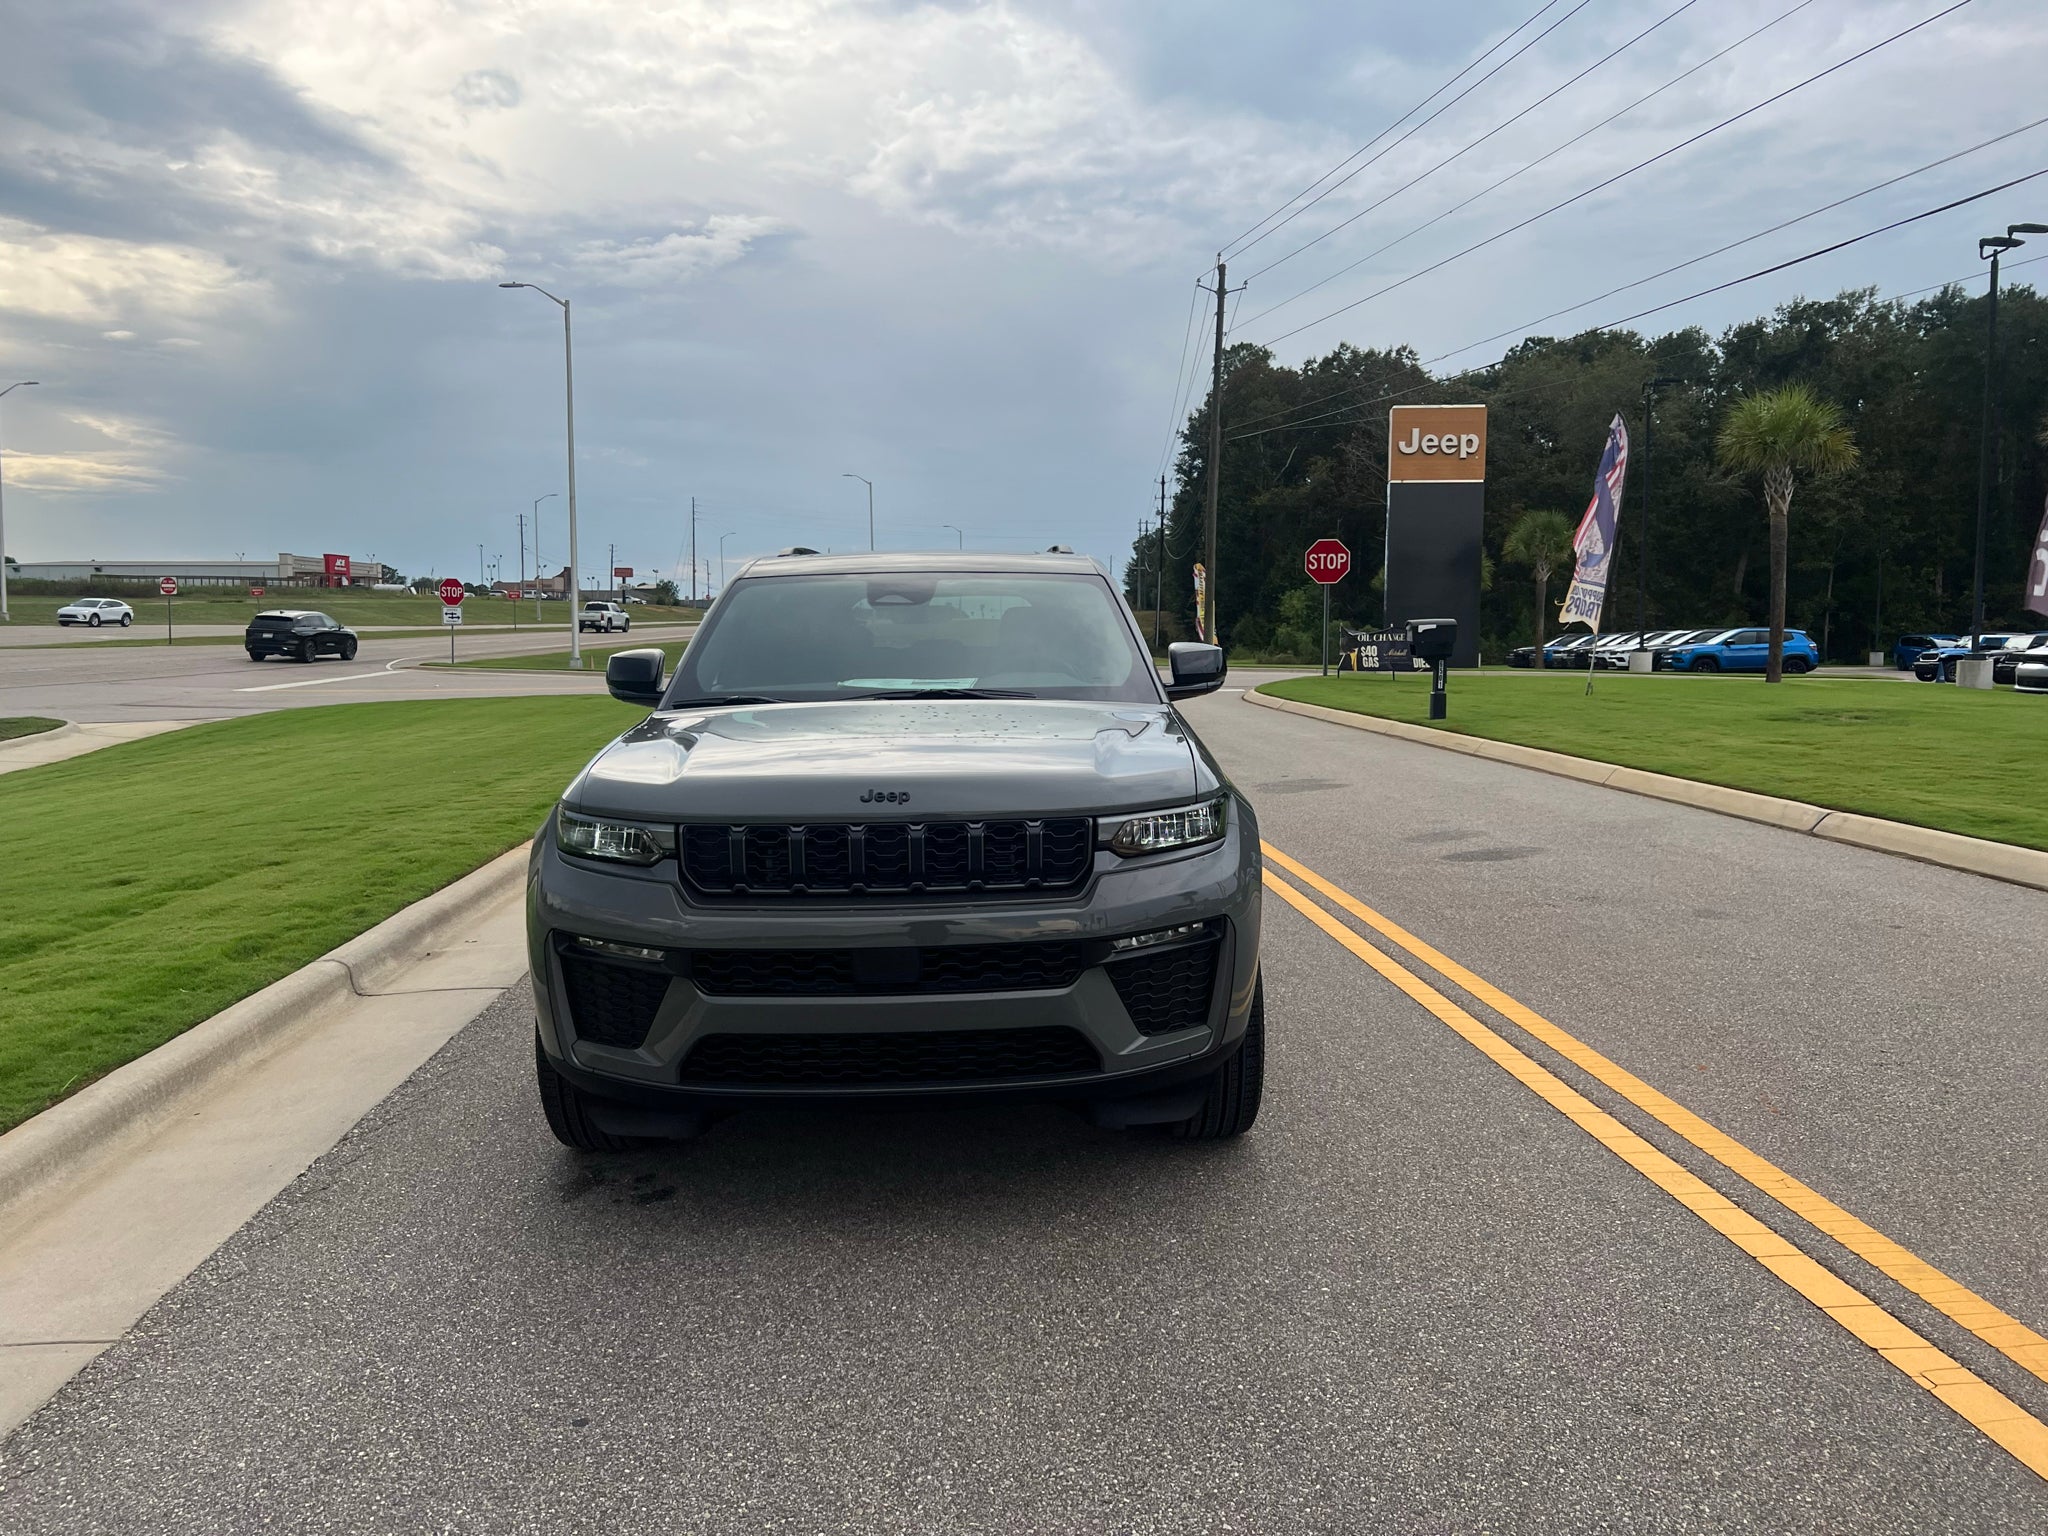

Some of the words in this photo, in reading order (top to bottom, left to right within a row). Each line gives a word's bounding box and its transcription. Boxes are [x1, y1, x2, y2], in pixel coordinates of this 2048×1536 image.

[1398, 427, 1480, 459] Jeep
[1308, 553, 1347, 570] STOP
[441, 586, 463, 598] STOP
[1357, 633, 1372, 642] OIL
[1373, 633, 1406, 642] CHANGE
[1360, 645, 1378, 657] $40
[1362, 656, 1380, 668] GAS
[1412, 657, 1431, 668] DIE
[860, 789, 911, 806] Jeep
